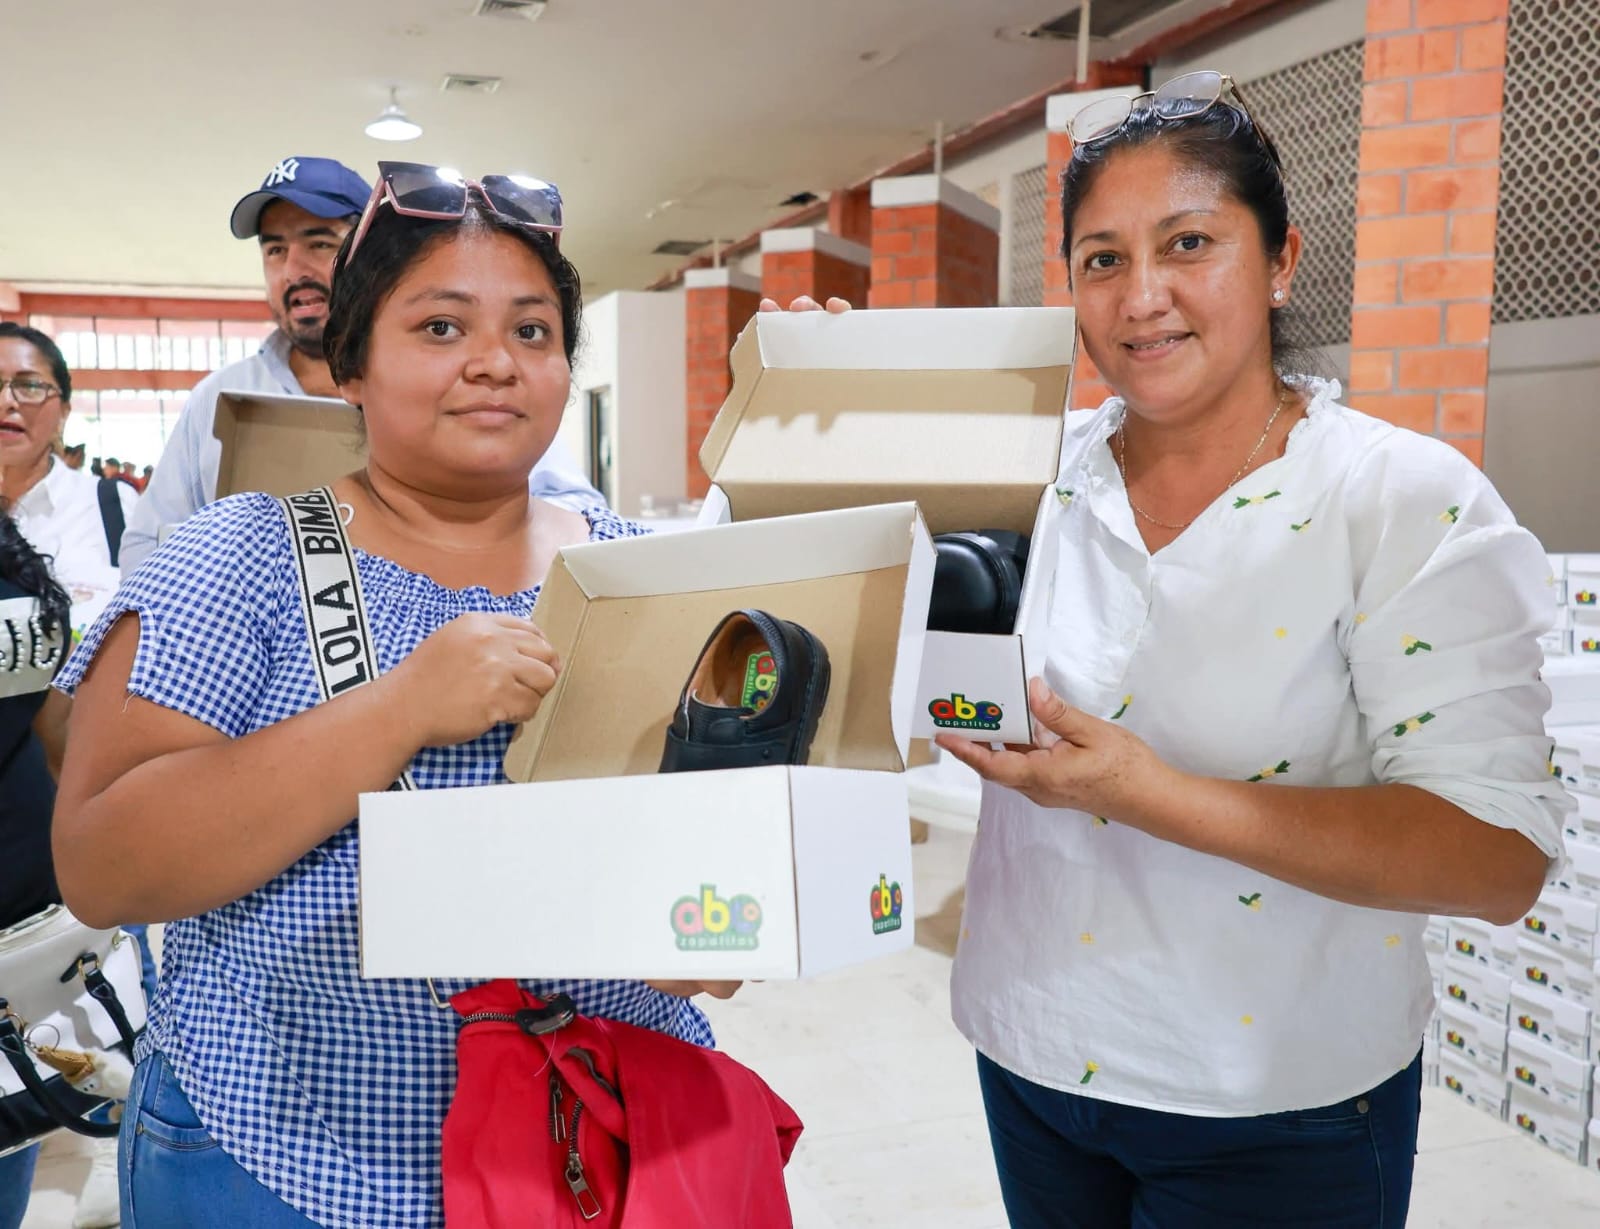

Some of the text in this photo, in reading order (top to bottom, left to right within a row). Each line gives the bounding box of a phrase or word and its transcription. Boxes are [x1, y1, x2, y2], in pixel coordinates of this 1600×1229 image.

[266, 158, 300, 187] NY
[290, 490, 368, 695] LOLA BIMB
